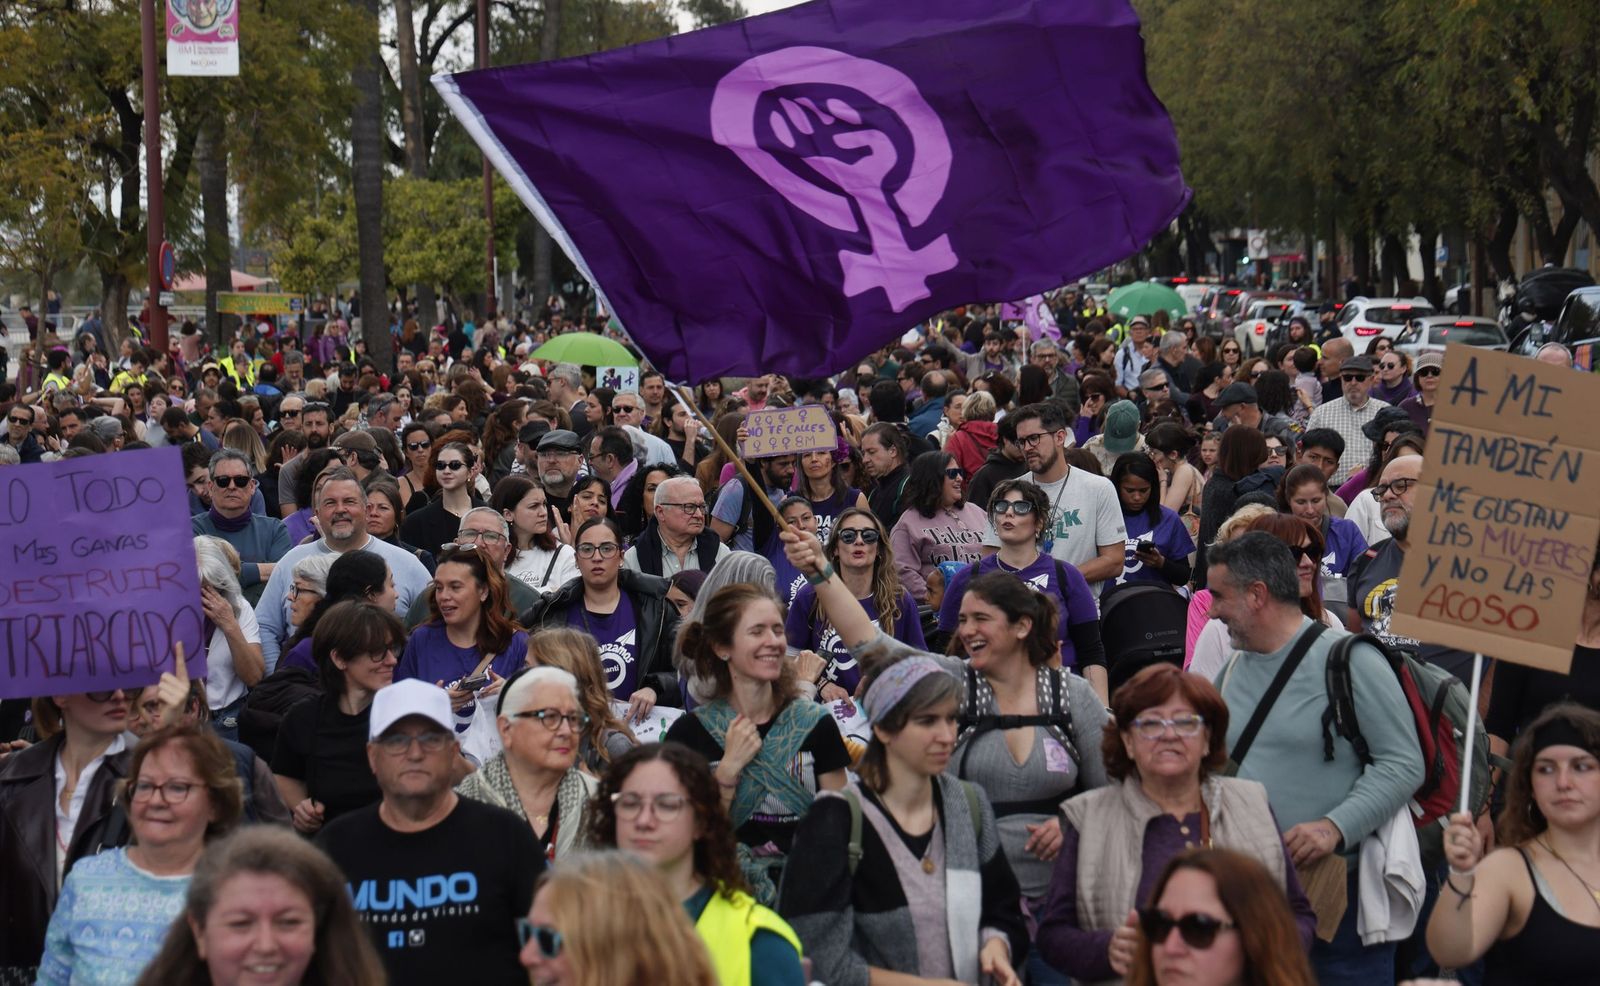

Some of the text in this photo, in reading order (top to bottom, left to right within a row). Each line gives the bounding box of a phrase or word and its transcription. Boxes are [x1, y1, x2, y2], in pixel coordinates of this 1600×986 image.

[1450, 356, 1562, 418] A MI
[747, 423, 826, 438] NO TE CALLES
[794, 434, 816, 448] 8M
[1434, 427, 1583, 485] TAMBIÉN
[54, 470, 166, 514] TODO
[1428, 477, 1570, 532] ME GUSTAN
[71, 533, 150, 559] GANAS
[1427, 514, 1590, 579] LAS MUJERES
[1420, 553, 1442, 589] Y
[1503, 562, 1556, 600] LAS
[1417, 583, 1541, 632] ACOSO
[344, 871, 479, 911] MUNDO
[412, 910, 428, 921] de
